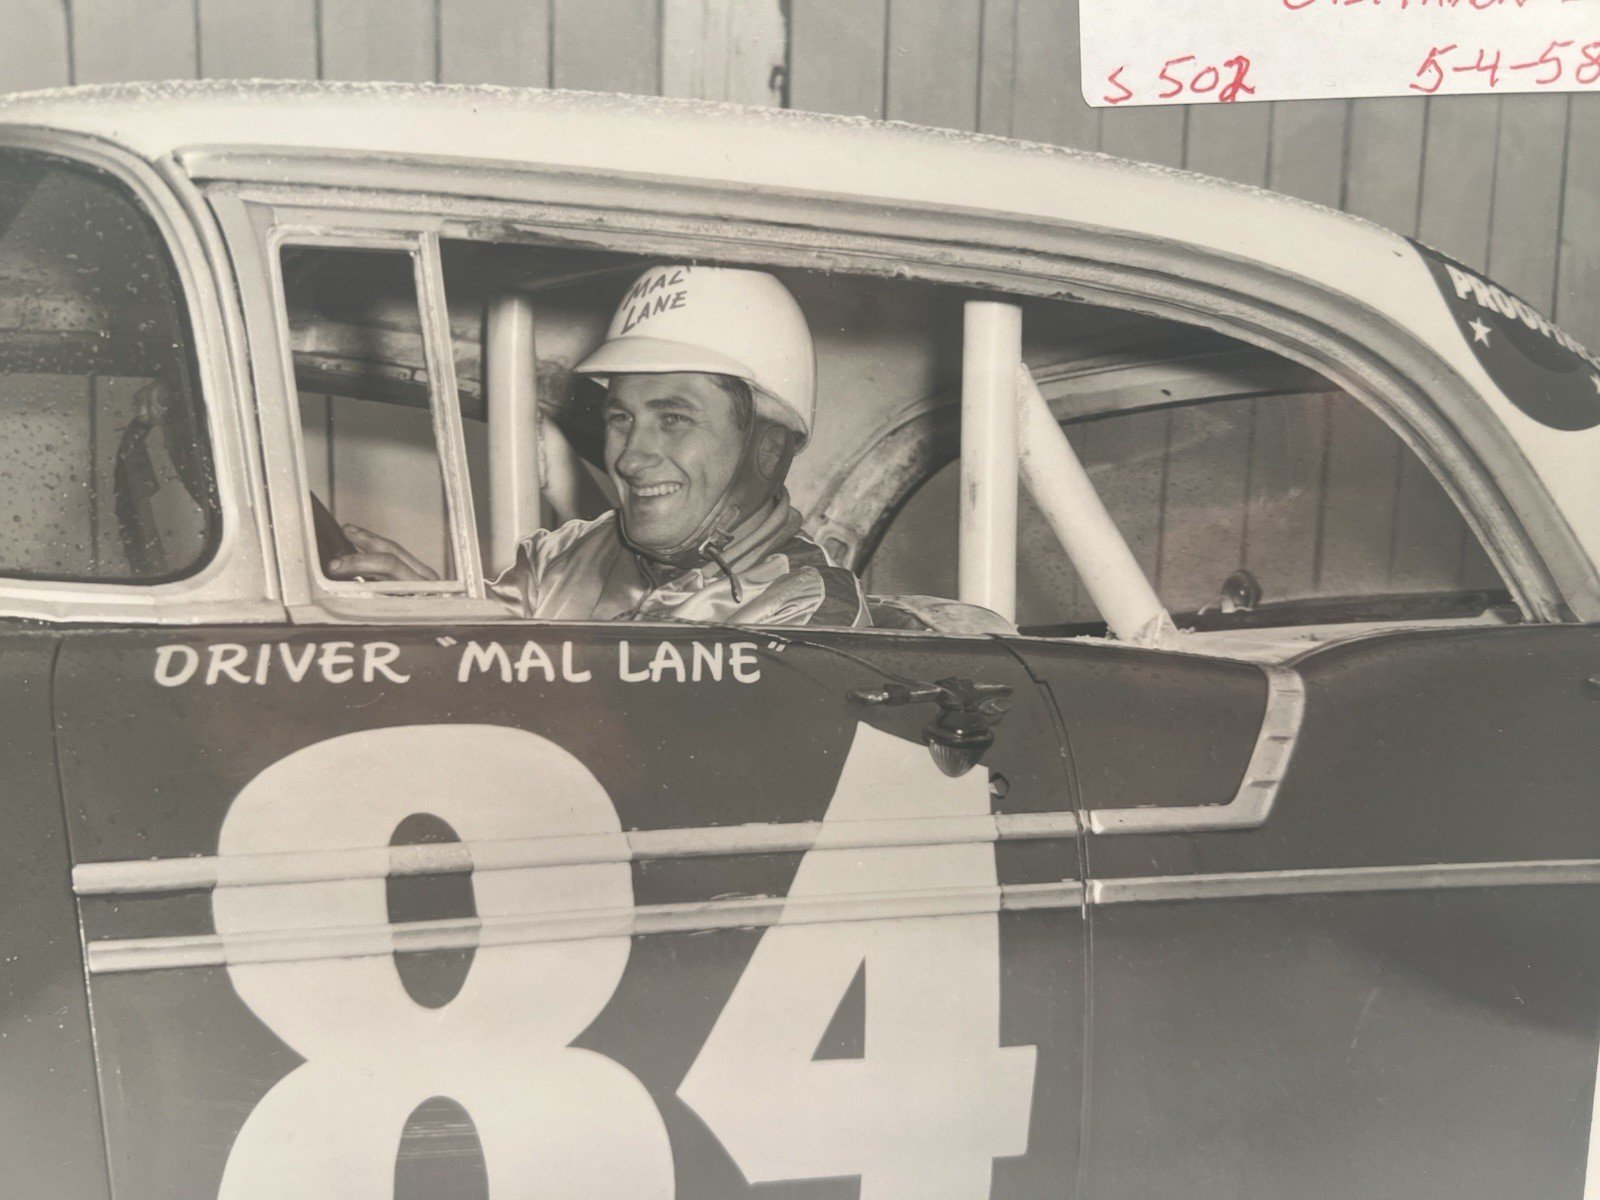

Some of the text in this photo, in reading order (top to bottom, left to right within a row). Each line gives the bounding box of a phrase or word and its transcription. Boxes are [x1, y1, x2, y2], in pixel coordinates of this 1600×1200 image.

[1409, 40, 1600, 93] 5-4-58
[620, 290, 688, 335] LANE
[154, 641, 411, 687] DRIVER
[212, 721, 1038, 1200] 84
